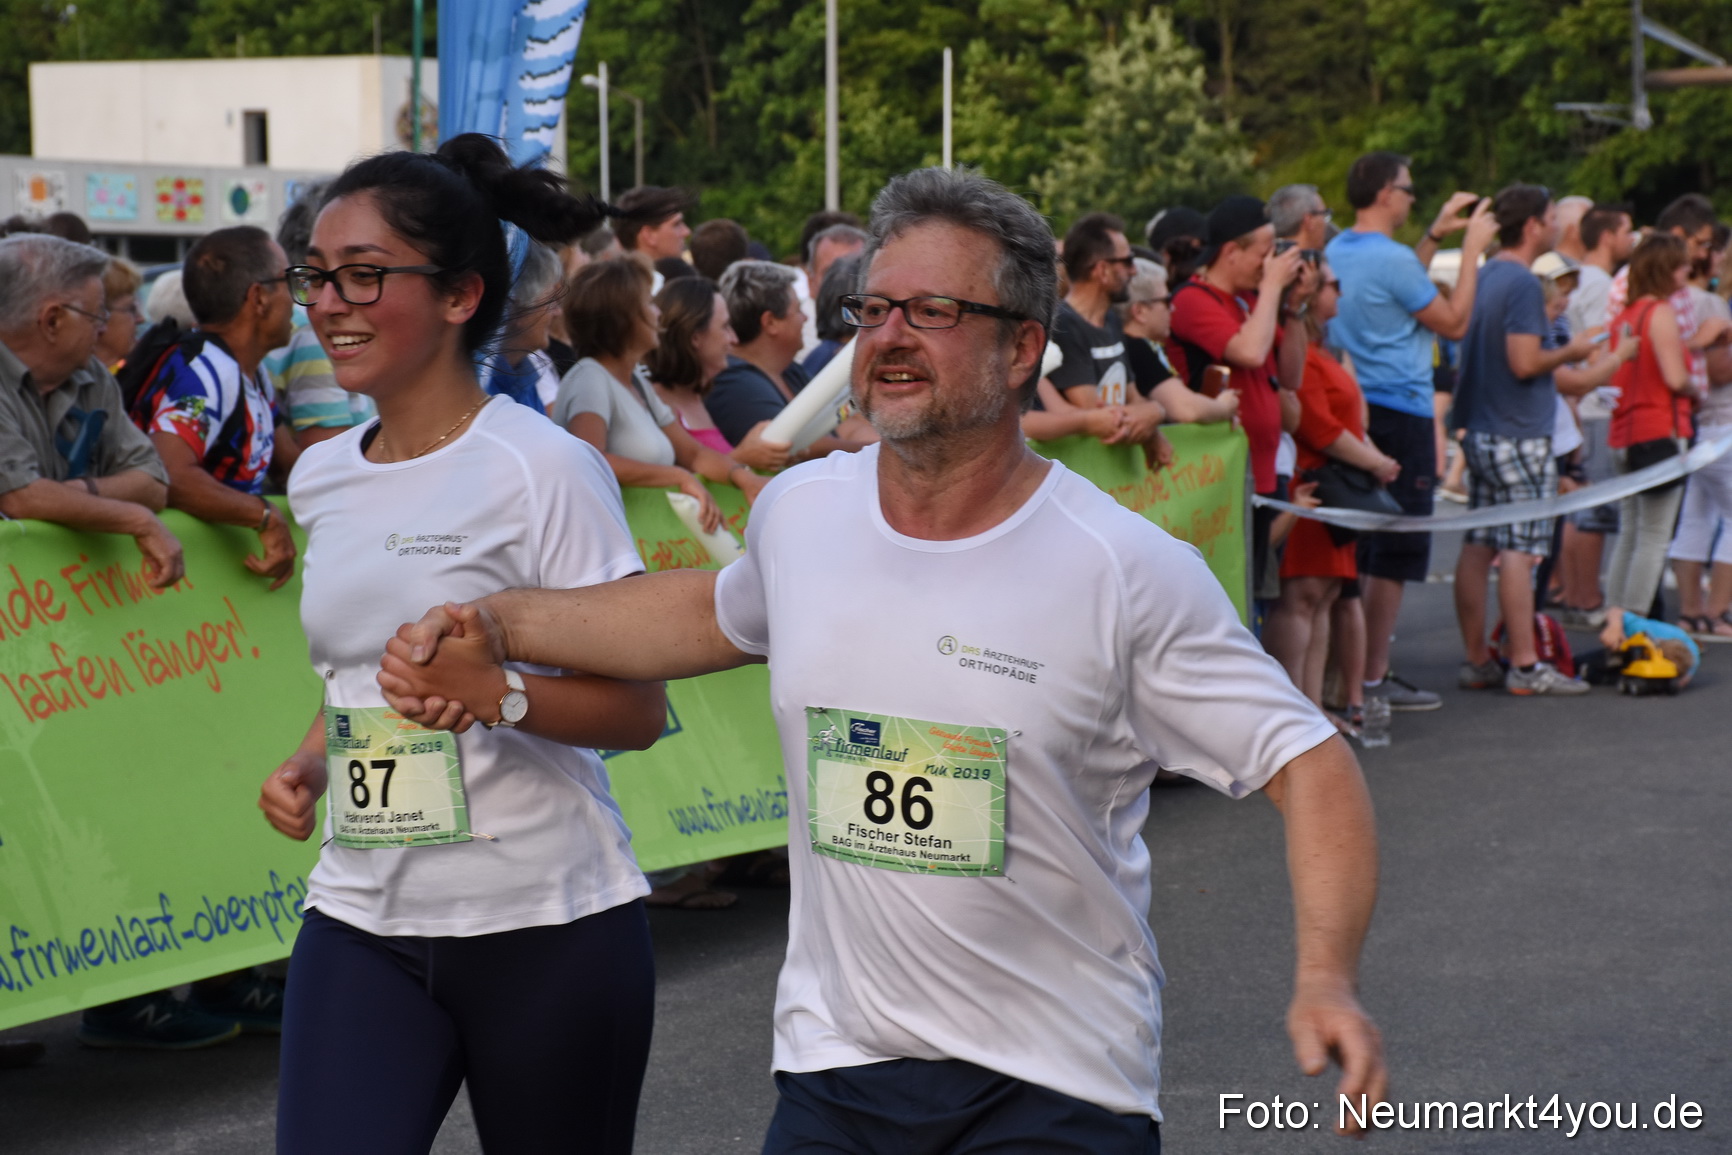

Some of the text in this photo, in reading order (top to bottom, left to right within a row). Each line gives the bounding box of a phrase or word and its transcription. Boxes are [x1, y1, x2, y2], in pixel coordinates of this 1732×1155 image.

[398, 544, 462, 556] ORTHOPÄDIE
[1, 596, 260, 723] laufen länger!
[961, 645, 981, 656] DAS
[959, 657, 1037, 684] ORTHOPÄDIE
[410, 740, 443, 754] 2019
[835, 738, 909, 762] firmenlauf
[348, 758, 397, 809] 87
[924, 764, 991, 780] run 2019
[668, 775, 788, 836] www.firmenla
[863, 770, 934, 830] 86
[388, 809, 425, 823] Janet
[396, 822, 440, 834] Neumarkt
[832, 835, 852, 848] BAG
[854, 840, 866, 851] im
[868, 842, 917, 858] Ärztehaus
[919, 849, 970, 863] Neumarkt
[847, 823, 952, 850] Fischer Stefan
